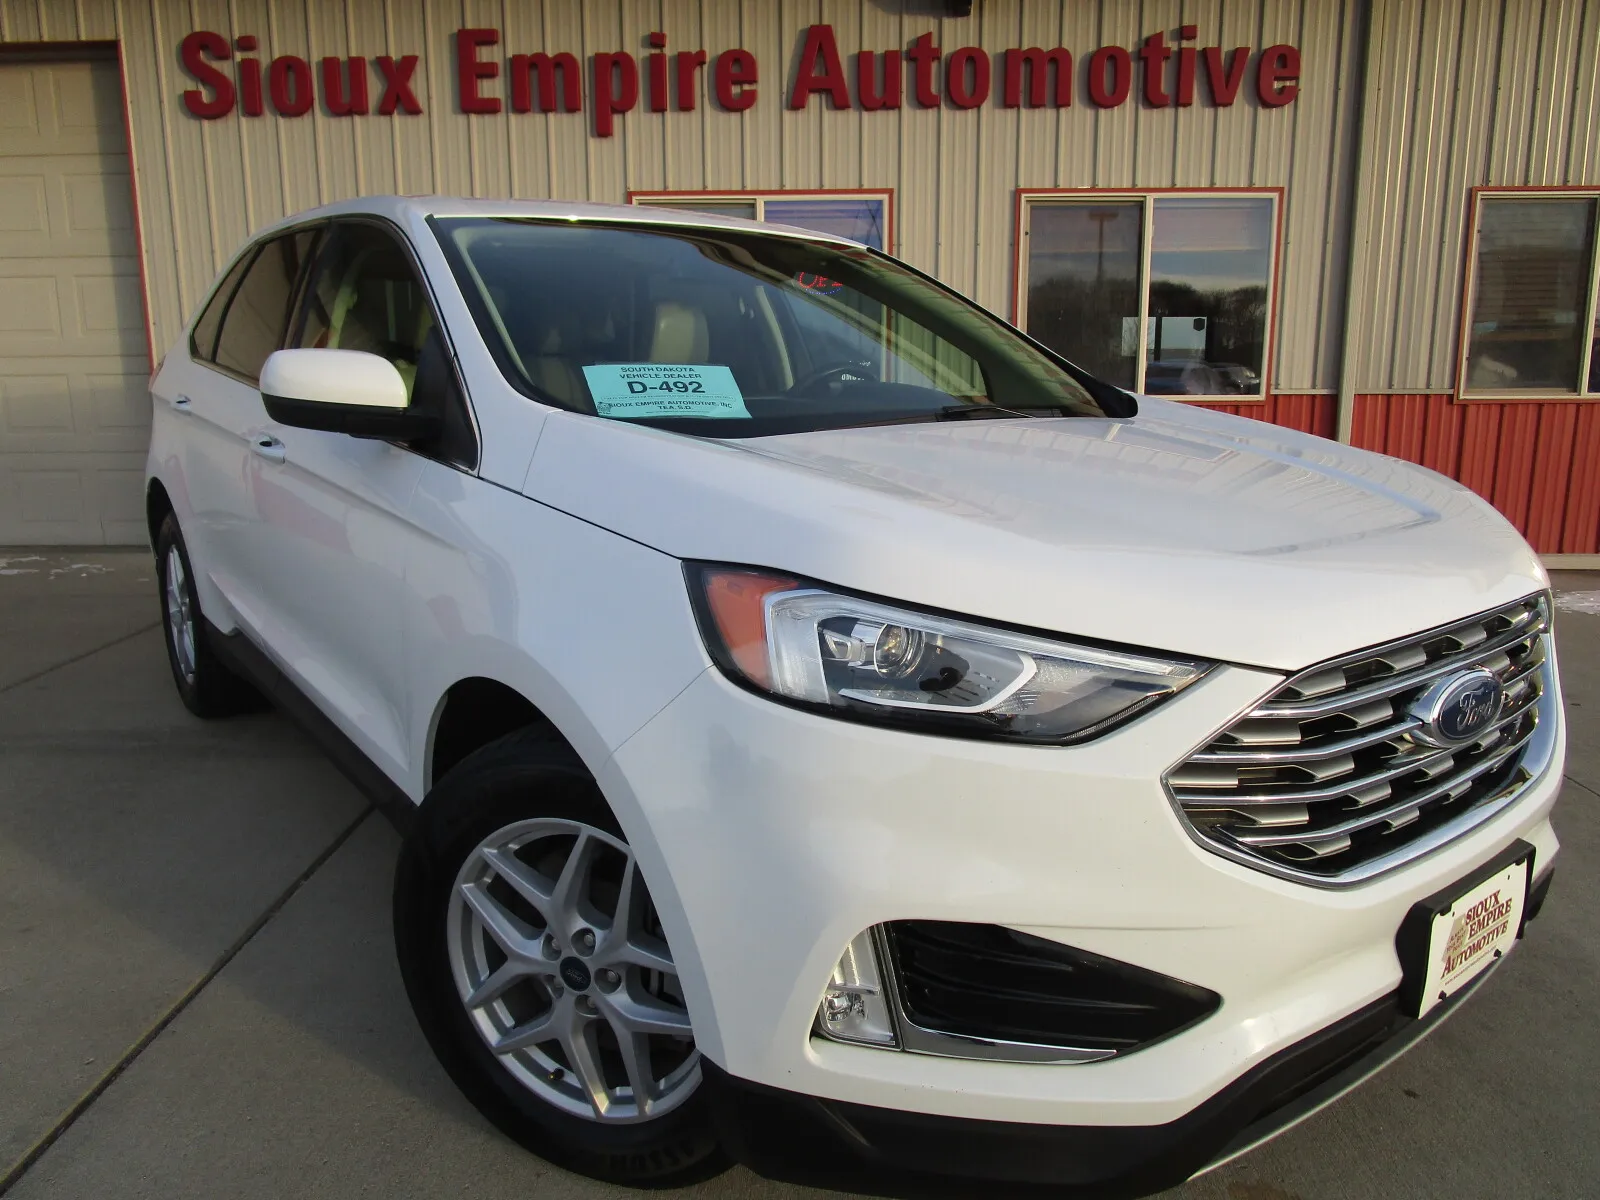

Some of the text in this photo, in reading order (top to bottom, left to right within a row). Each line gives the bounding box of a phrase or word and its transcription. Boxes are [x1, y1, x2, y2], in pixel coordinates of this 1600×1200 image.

[181, 25, 1301, 137] Sioux Empire Automotive
[627, 381, 706, 394] D-492
[1456, 686, 1495, 732] Ford
[1465, 889, 1501, 926] SIOUX
[1467, 897, 1513, 940] EMPIRE
[1440, 919, 1509, 979] AUTOMOTIVE
